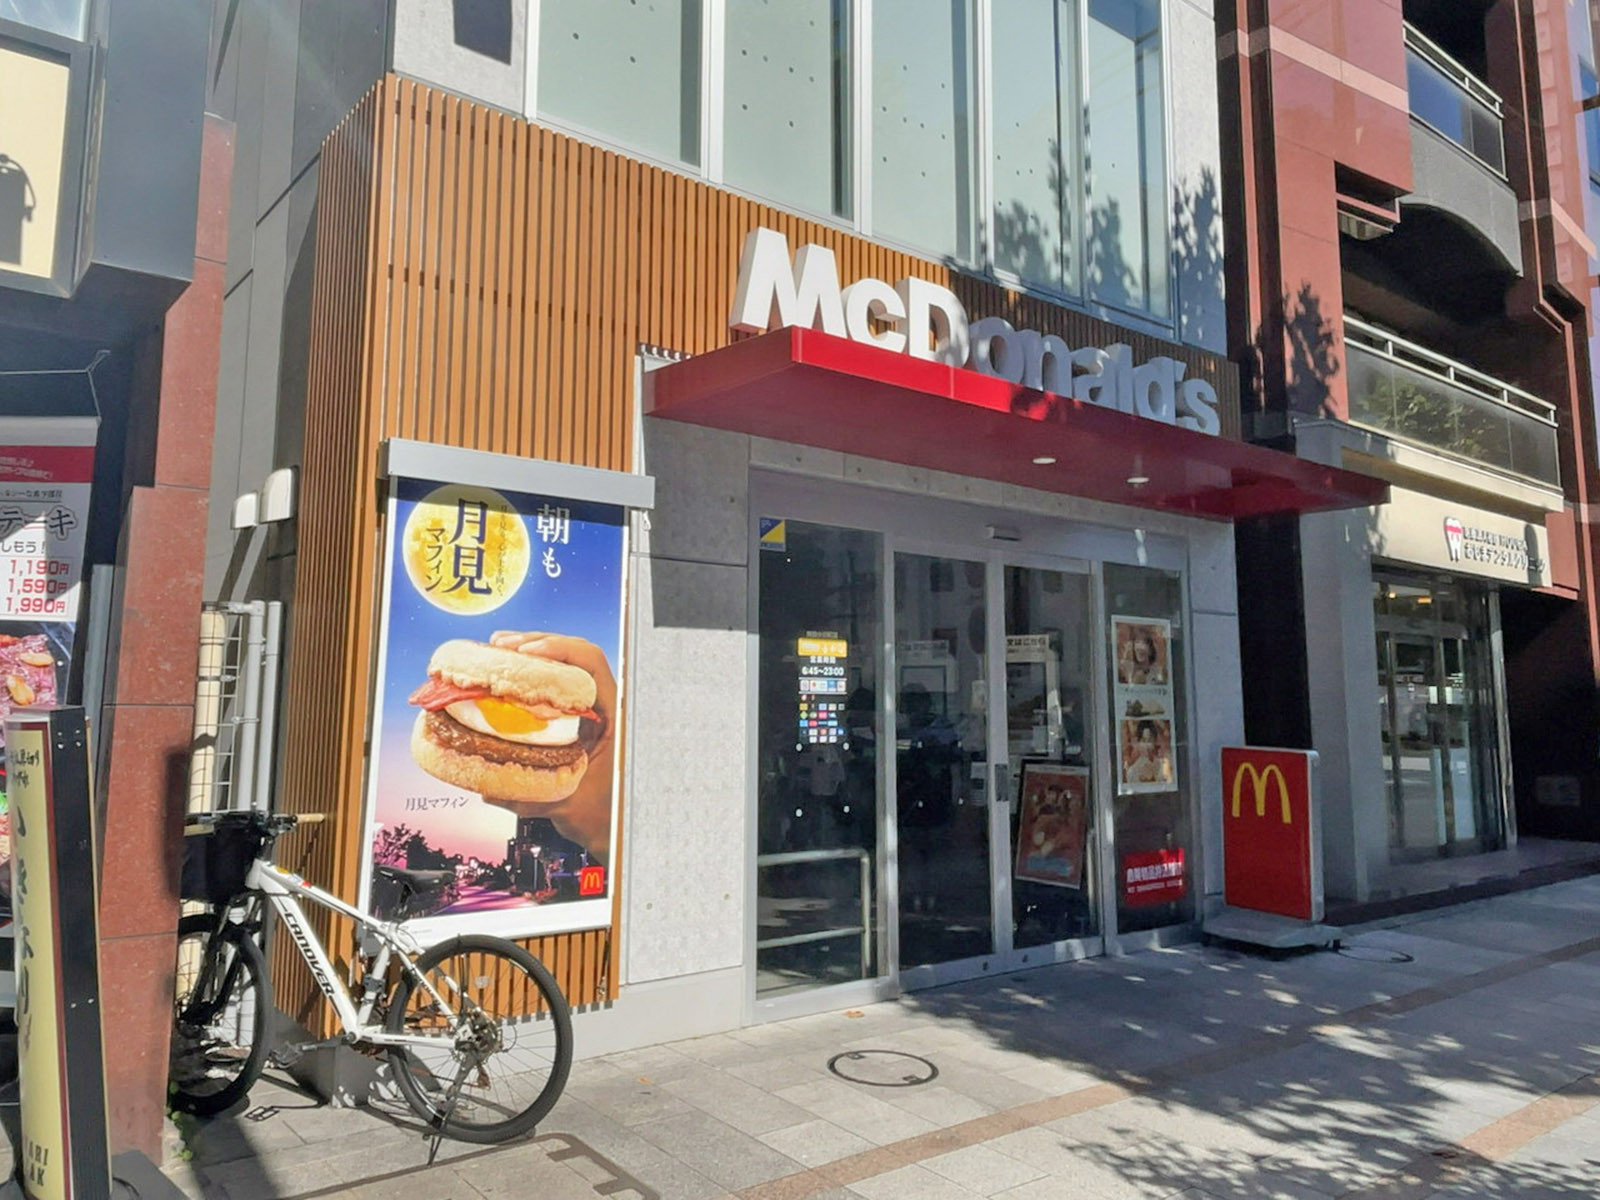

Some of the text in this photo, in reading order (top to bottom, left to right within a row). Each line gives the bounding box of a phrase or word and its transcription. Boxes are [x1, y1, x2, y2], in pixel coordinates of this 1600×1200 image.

[729, 225, 1220, 437] McDonald's
[10, 559, 69, 577] 1,190円
[424, 526, 446, 593] マフィン
[442, 498, 493, 595] 月見
[536, 504, 571, 578] 朝も
[6, 597, 66, 615] 1,990円
[8, 578, 68, 595] 1,590円
[405, 796, 469, 811] 月見マフィン
[284, 911, 335, 996] CANOVER
